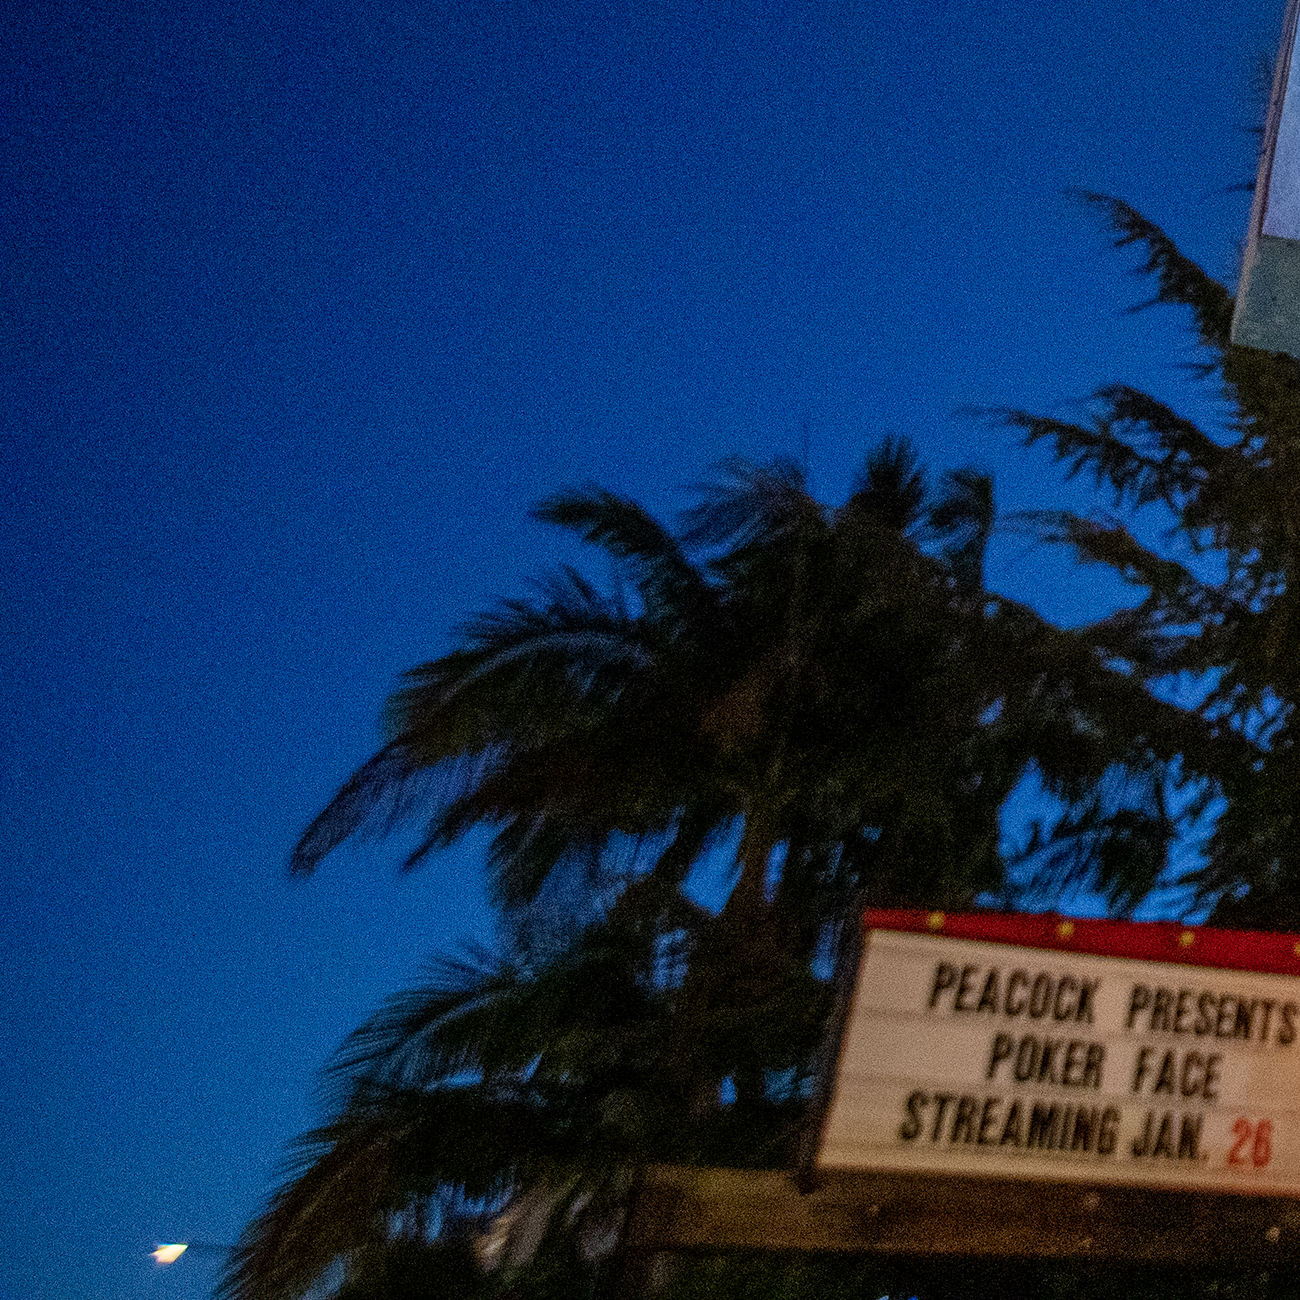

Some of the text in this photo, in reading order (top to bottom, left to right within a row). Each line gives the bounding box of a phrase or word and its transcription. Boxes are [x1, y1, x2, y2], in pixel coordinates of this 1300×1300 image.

[928, 962, 1300, 1046] PEACOCK PRESENTS
[985, 1033, 1225, 1101] POKER FACE
[898, 1089, 1274, 1169] STREAMING JAN. 26
